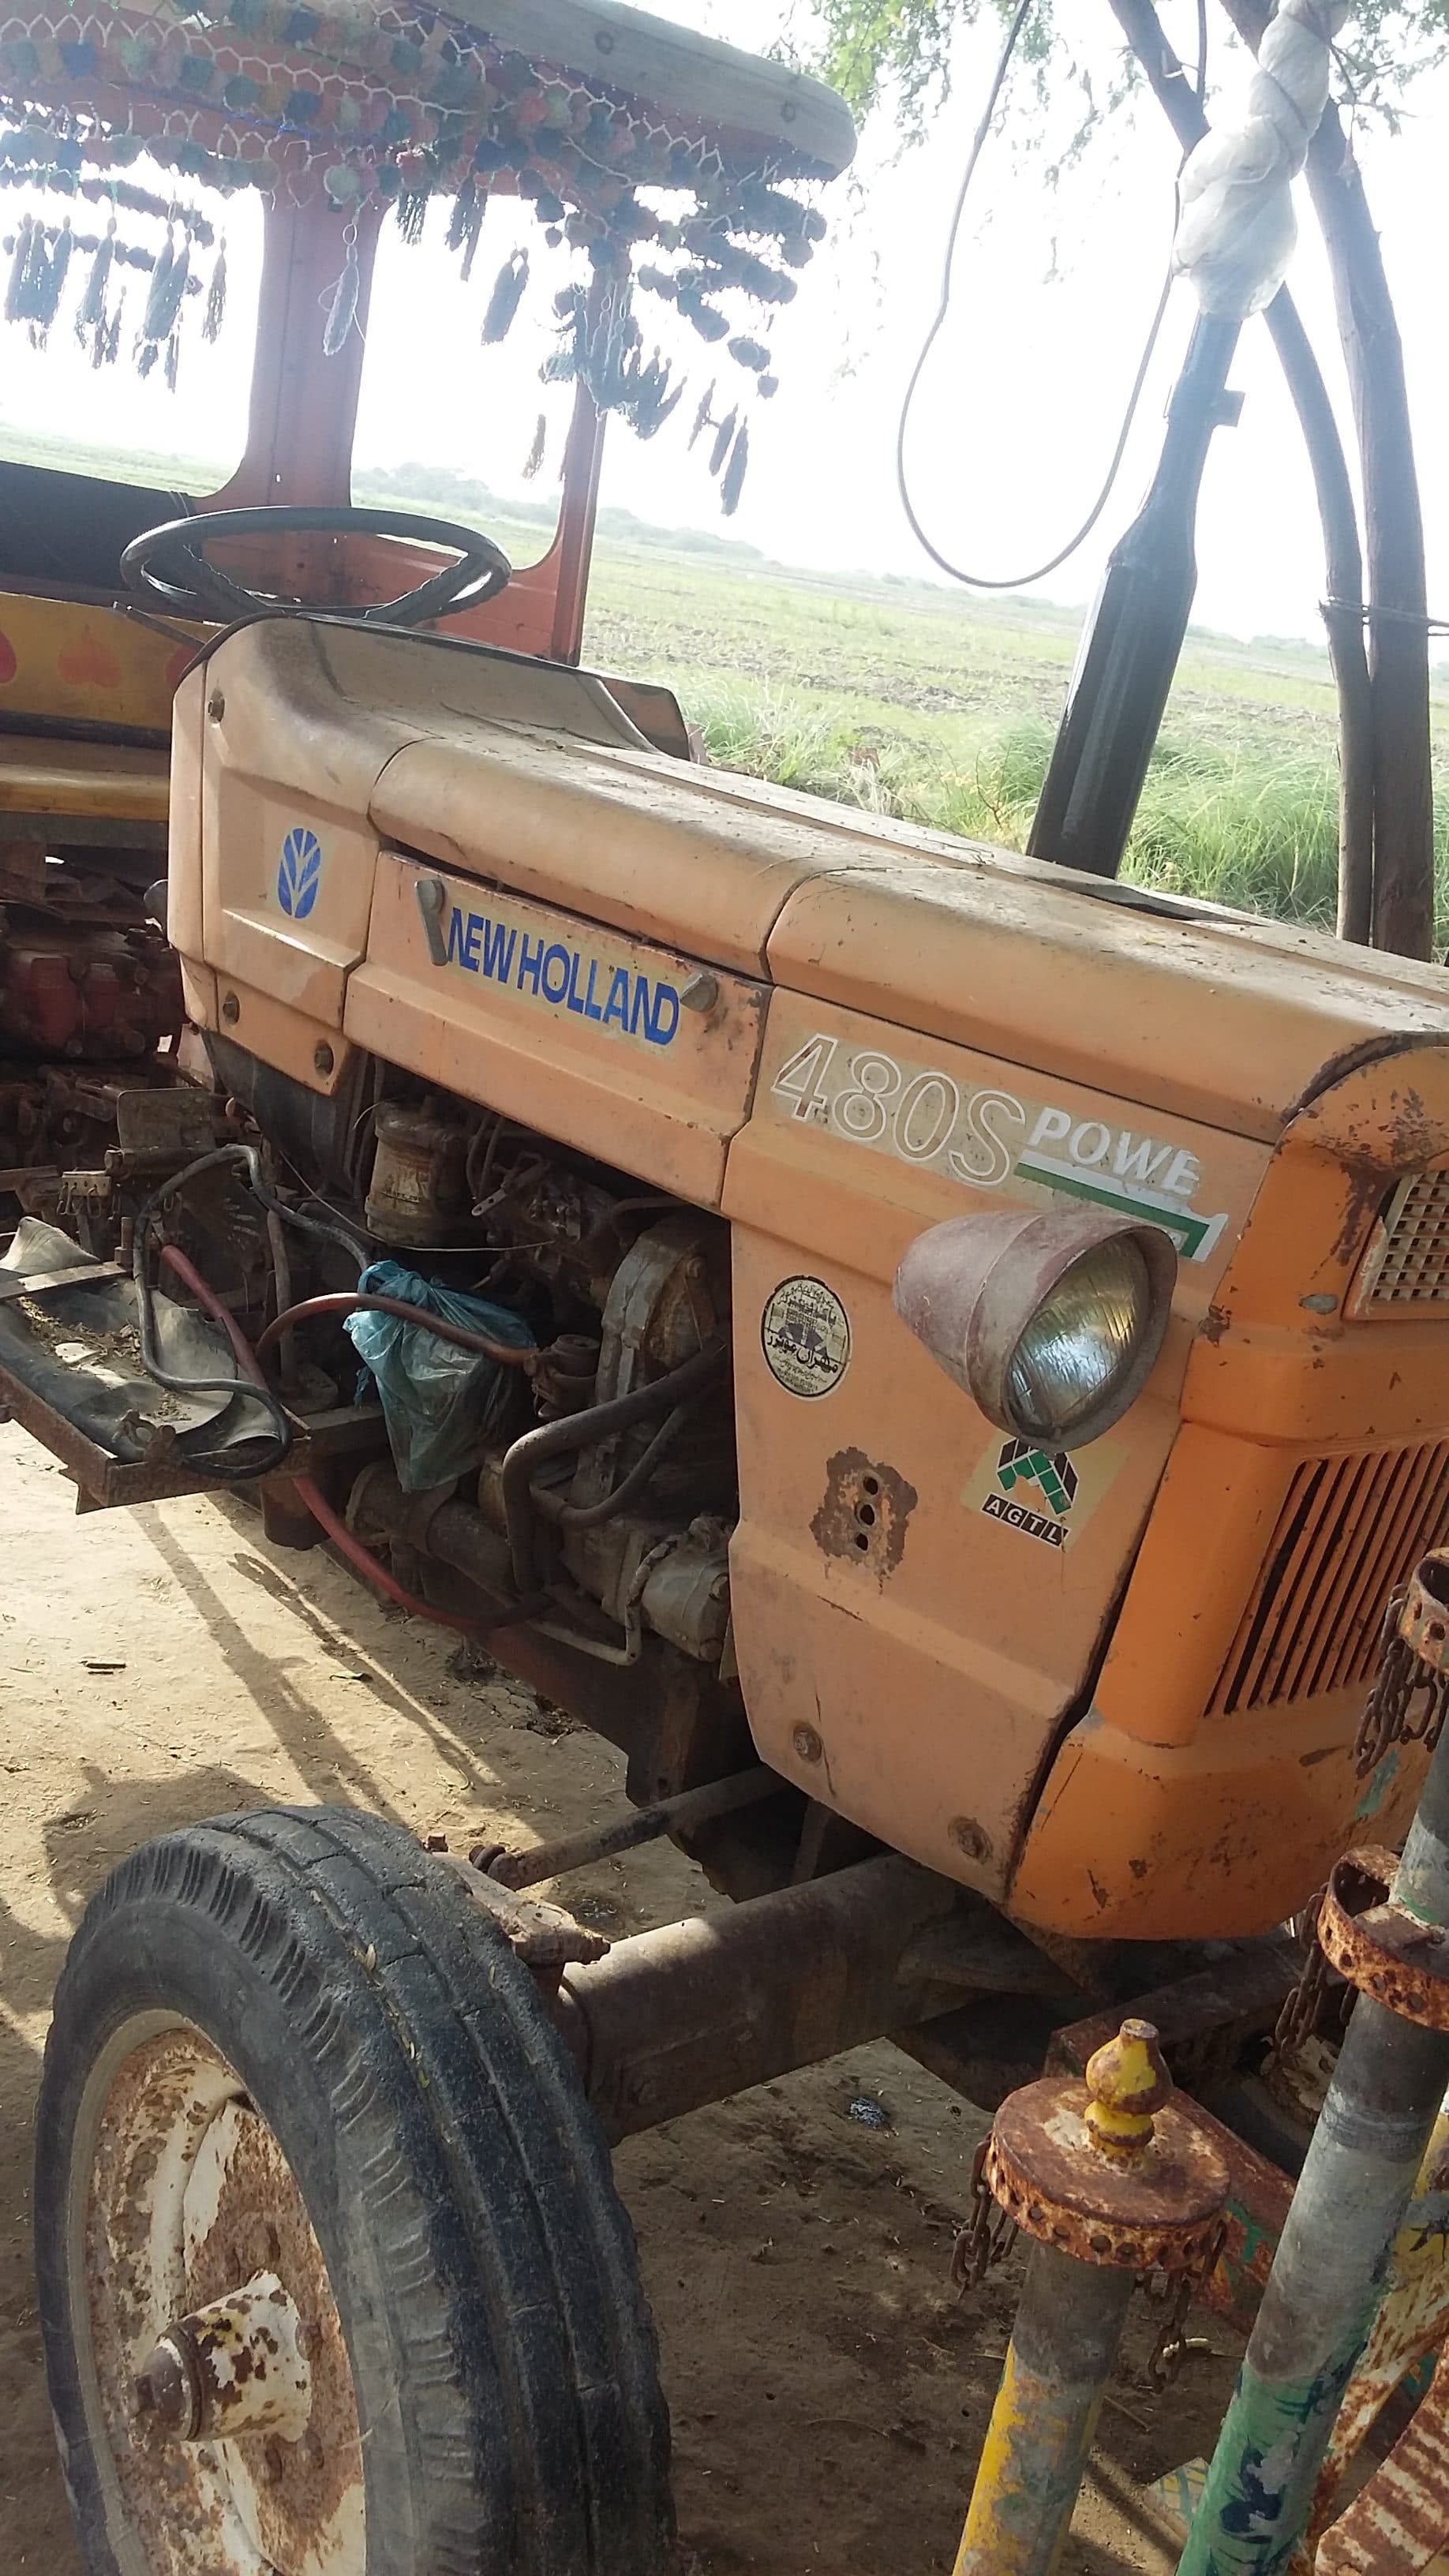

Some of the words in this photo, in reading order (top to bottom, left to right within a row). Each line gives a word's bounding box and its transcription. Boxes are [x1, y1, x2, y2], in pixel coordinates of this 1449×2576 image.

[448, 907, 517, 983] NEW
[517, 934, 680, 1046] HOLLAND
[770, 1033, 1025, 1185] 480S
[985, 1499, 1058, 1542] AGTL
